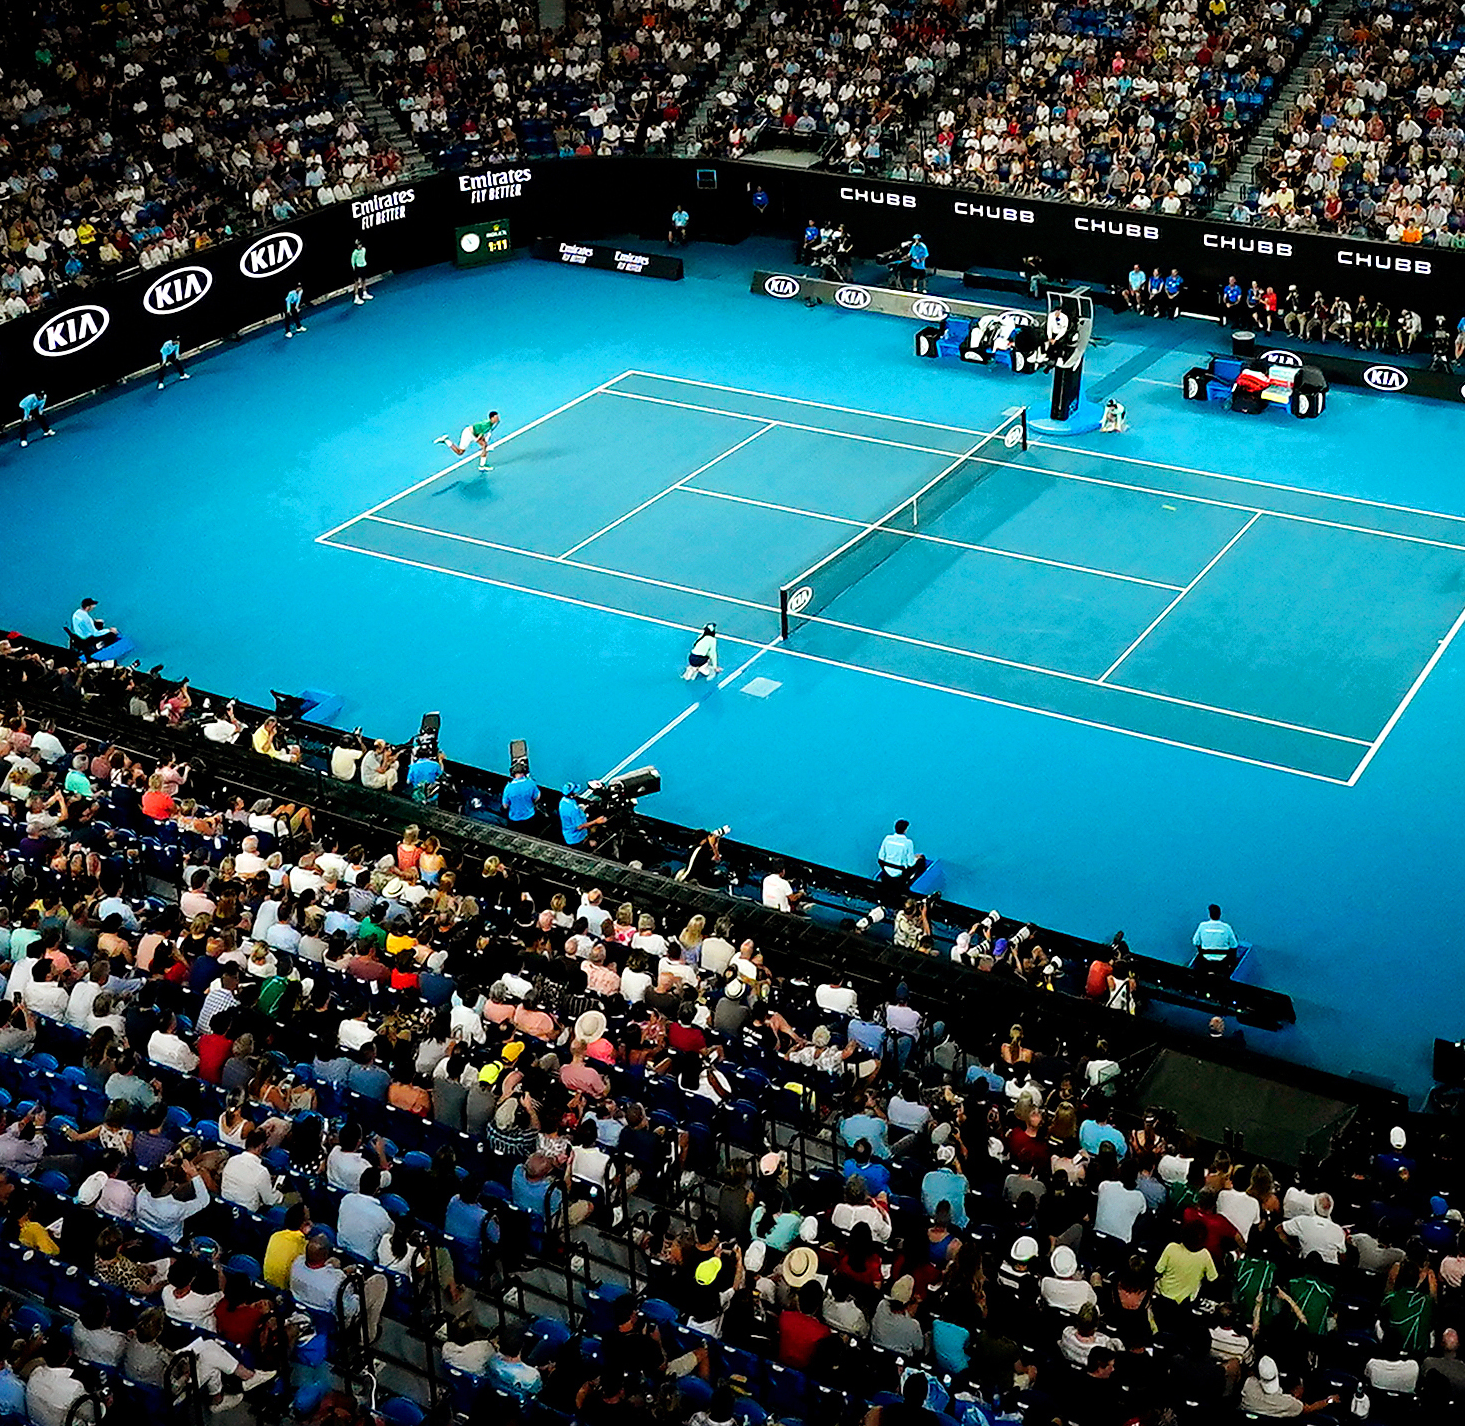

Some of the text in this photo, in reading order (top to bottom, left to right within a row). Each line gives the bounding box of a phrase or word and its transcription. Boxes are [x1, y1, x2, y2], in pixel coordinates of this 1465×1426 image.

[459, 168, 532, 192] Emirates
[351, 188, 415, 219] Emirates
[471, 184, 522, 204] FLY BETTER
[840, 187, 917, 208] CHUBB
[361, 205, 406, 230] FLY BETTER
[954, 201, 1035, 224] CHUBB
[1074, 217, 1159, 240] CHUBB
[250, 238, 294, 273] KIA
[1203, 233, 1293, 257] CHUBB
[1337, 250, 1432, 275] CHUBB
[155, 273, 203, 309] KIA
[770, 279, 793, 294] KIA
[841, 290, 864, 305] KIA
[918, 302, 944, 318] KIA
[45, 312, 98, 351] KIA
[1371, 369, 1400, 387] KIA
